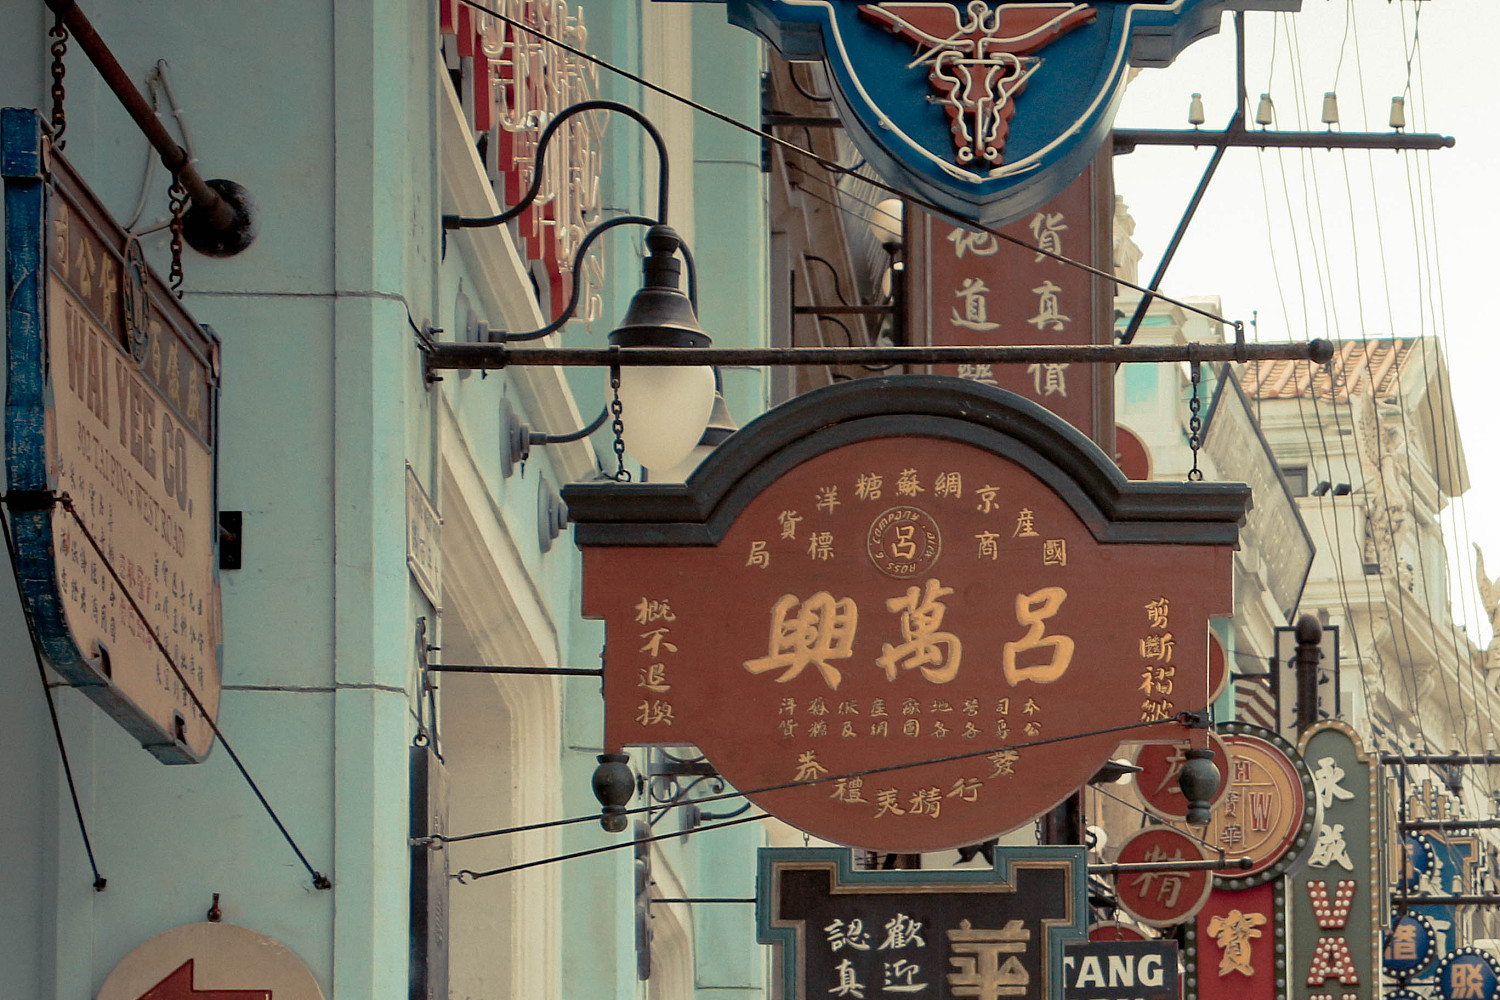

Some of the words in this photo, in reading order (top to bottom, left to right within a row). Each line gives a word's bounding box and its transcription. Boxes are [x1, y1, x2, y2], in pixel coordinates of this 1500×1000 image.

[65, 298, 110, 431] WAI
[115, 355, 156, 481] YEE
[162, 411, 193, 520] CO.
[891, 525, 917, 560] 呂
[634, 596, 679, 727] 概不退換
[743, 578, 1075, 691] 呂萬興
[1249, 791, 1273, 832] W
